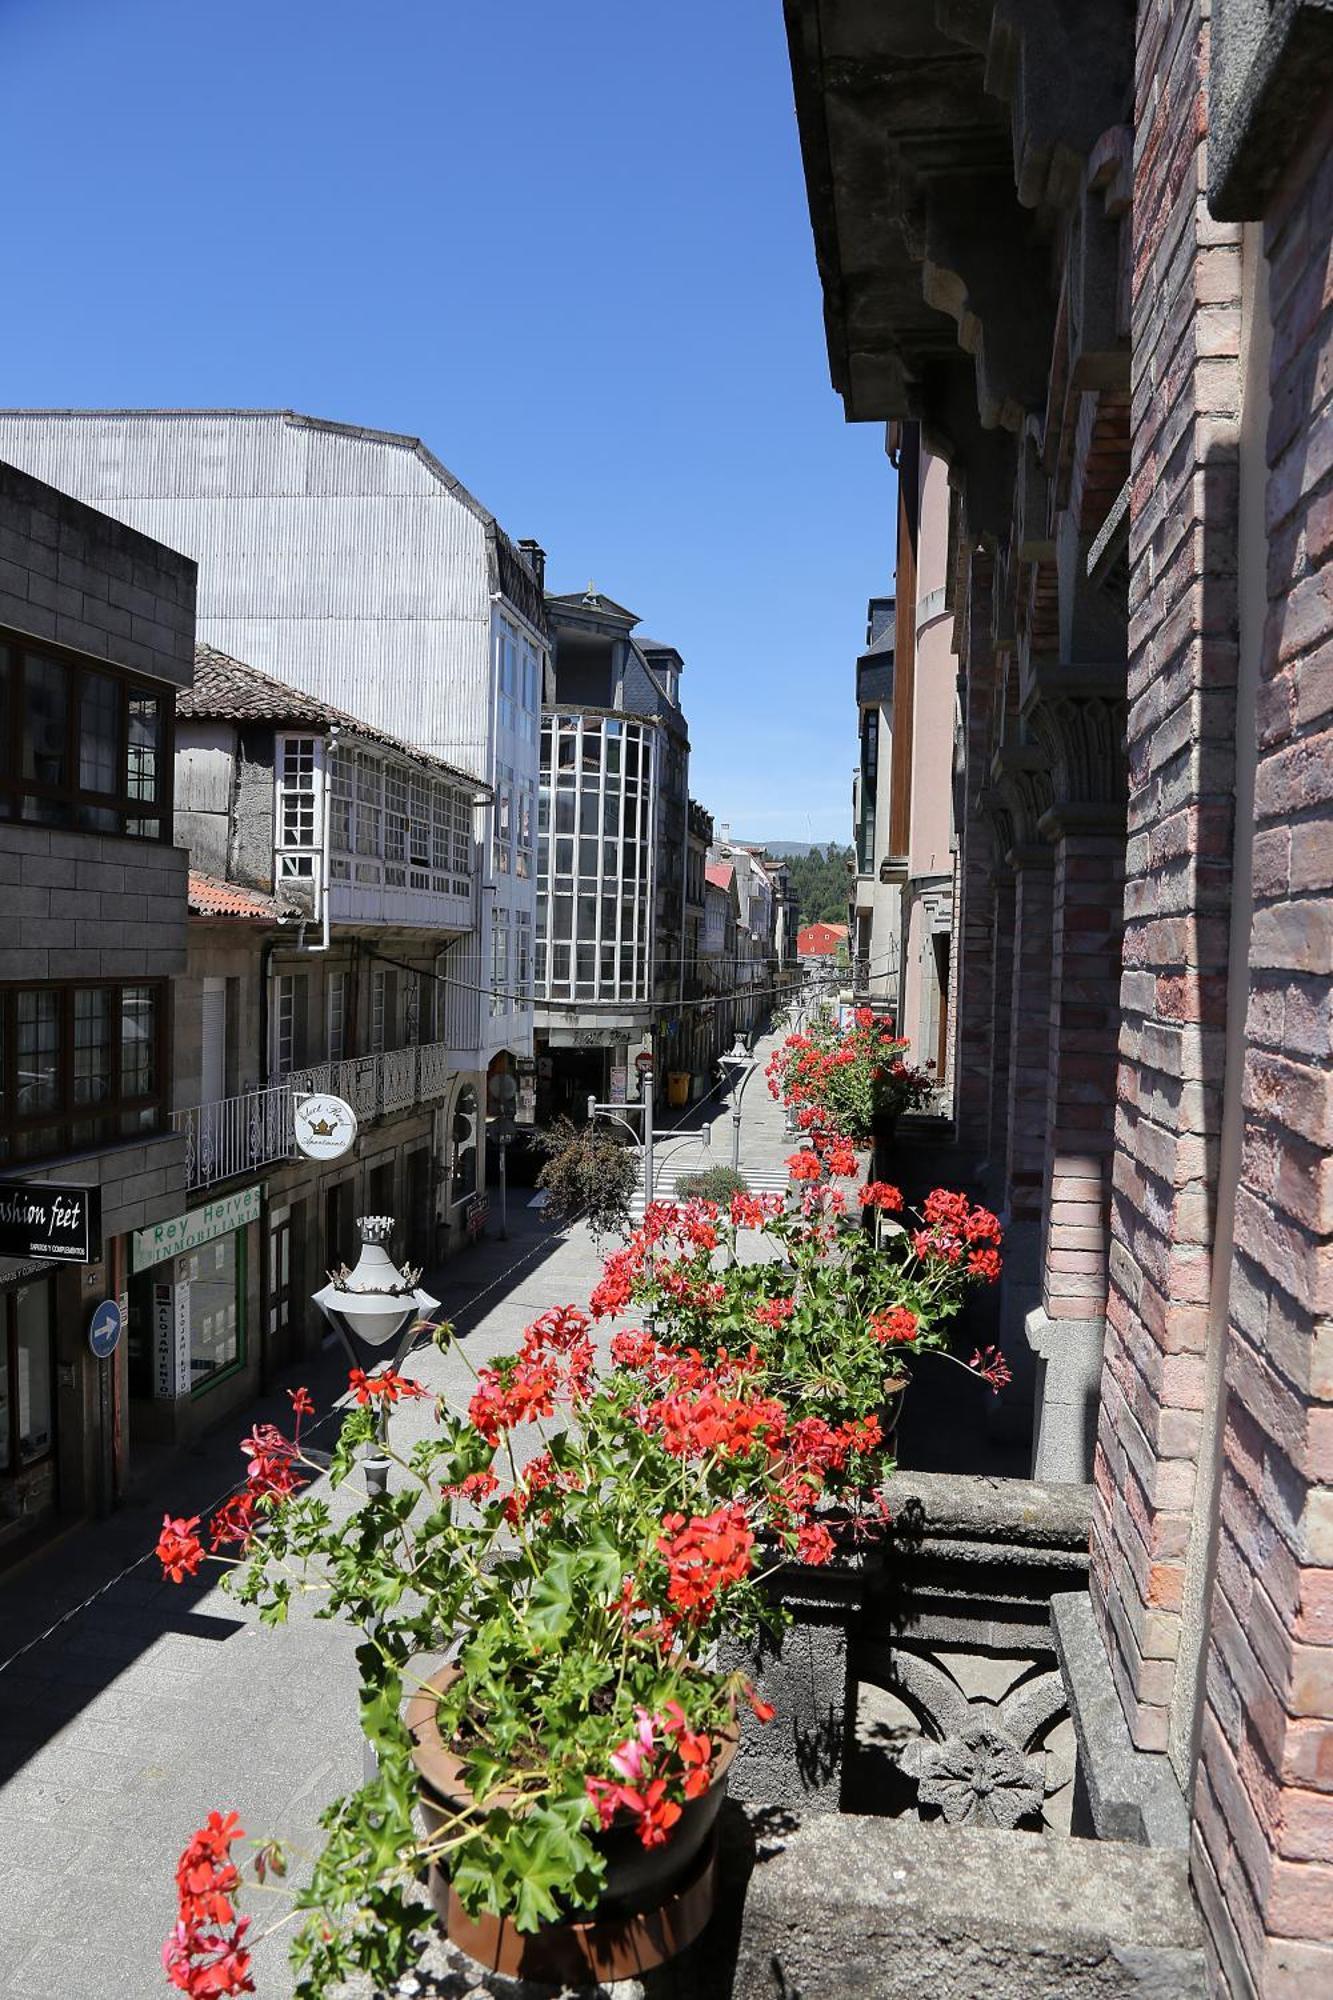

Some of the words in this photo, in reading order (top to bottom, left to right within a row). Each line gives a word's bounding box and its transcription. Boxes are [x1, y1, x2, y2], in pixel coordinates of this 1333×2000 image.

[154, 1217, 189, 1244] Rey
[155, 1208, 258, 1261] INMOBILIARIA
[160, 1307, 168, 1393] ALOJAMIENTO
